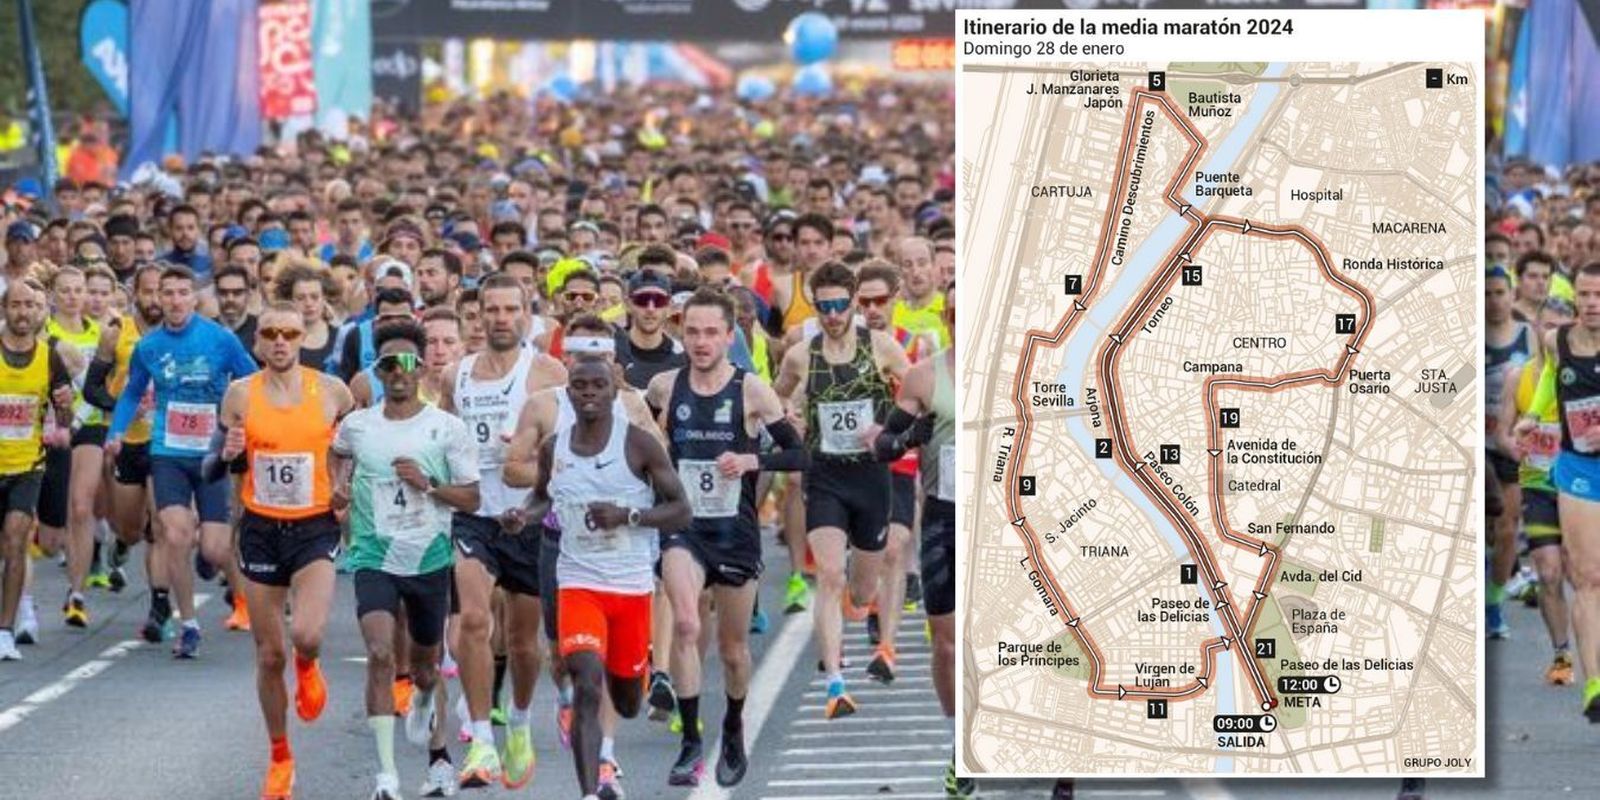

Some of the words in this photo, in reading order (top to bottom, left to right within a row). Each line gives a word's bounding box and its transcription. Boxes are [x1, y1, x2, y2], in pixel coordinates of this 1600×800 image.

[180, 414, 198, 429] 78
[831, 411, 858, 431] 26
[475, 421, 490, 444] 9
[266, 464, 295, 485] 16
[699, 471, 714, 493] 8
[393, 488, 407, 508] 4
